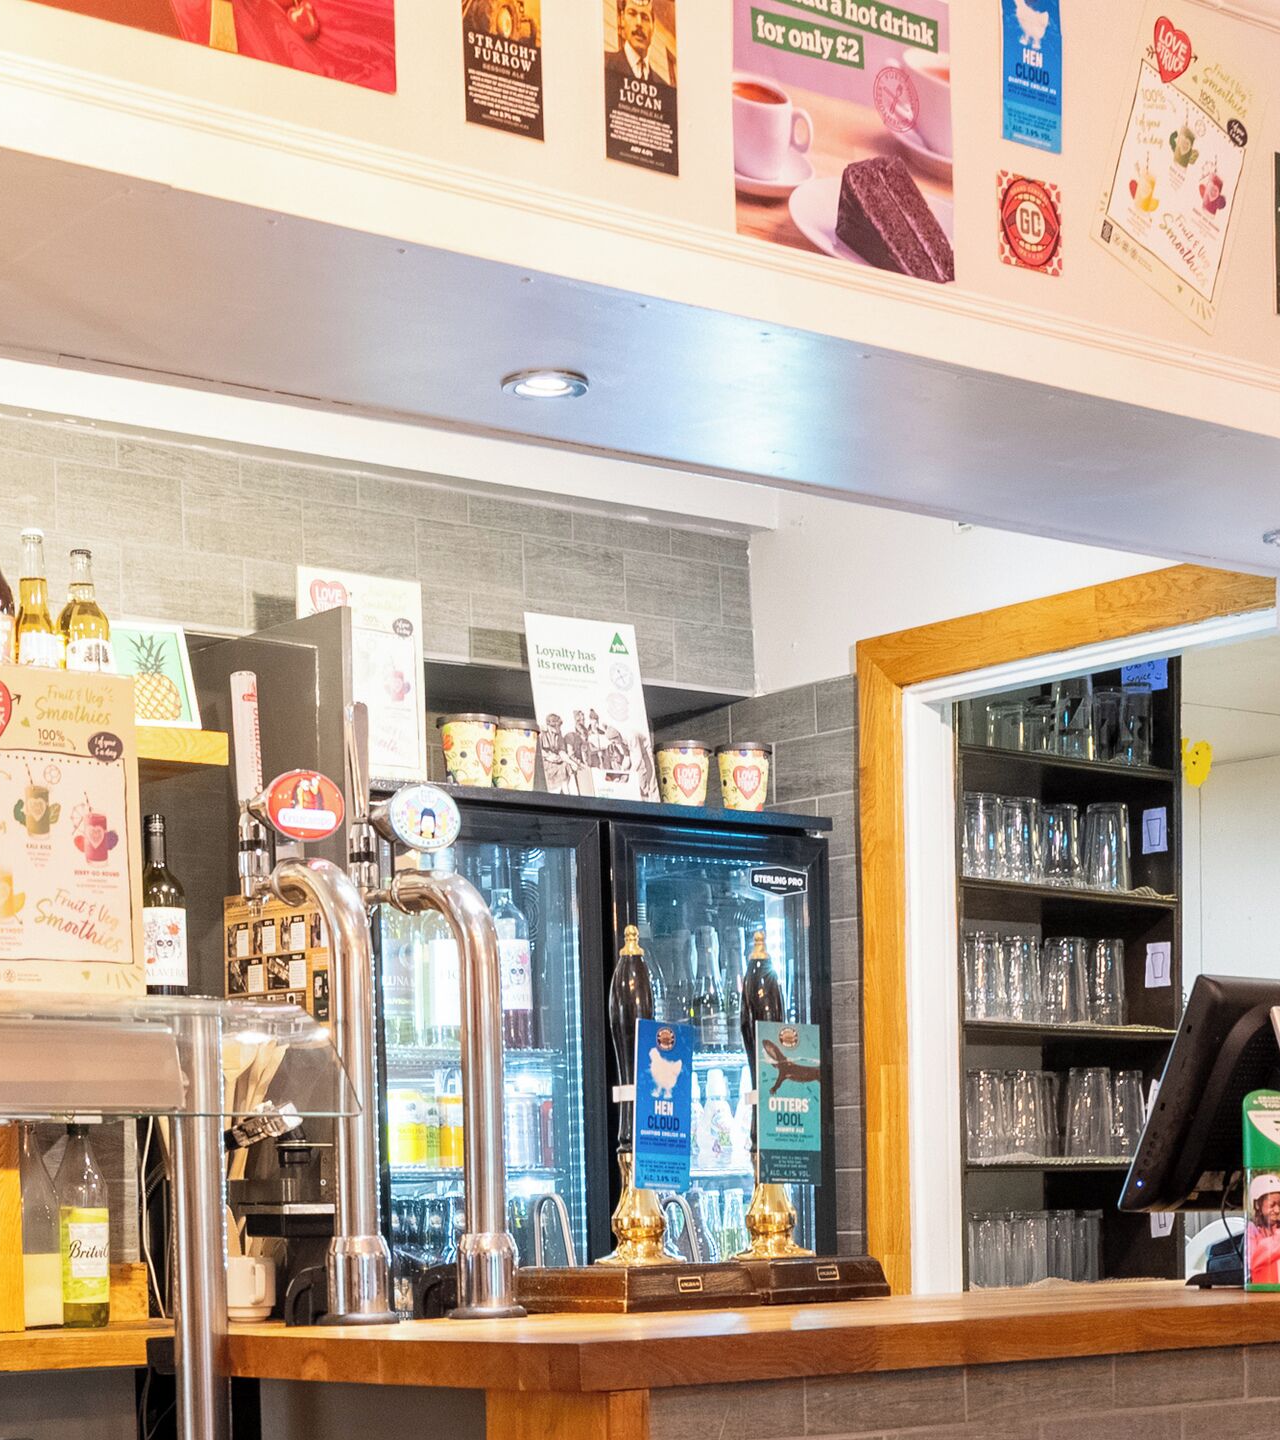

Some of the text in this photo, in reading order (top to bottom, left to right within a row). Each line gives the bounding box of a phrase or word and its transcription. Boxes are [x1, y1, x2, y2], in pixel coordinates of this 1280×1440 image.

[845, 1, 877, 30] hot
[880, 11, 934, 47] drink
[468, 32, 537, 61] STRAIGHT
[756, 15, 860, 63] for only £2
[1159, 25, 1188, 61] LOVE
[474, 47, 532, 72] FURROW
[1023, 48, 1043, 68] HEN
[1157, 42, 1184, 72] STRUCK
[482, 63, 525, 80] SESSION ALE
[1015, 63, 1050, 86] CLOUD
[624, 78, 658, 97] LORD
[620, 89, 662, 111] LUCAN
[1020, 208, 1040, 237] GC
[315, 585, 344, 603] LOVE
[536, 644, 597, 662] Loyalty has
[537, 659, 595, 674] its rewards
[48, 684, 74, 701] Fruit
[85, 688, 105, 708] Veg
[35, 697, 112, 725] Smoothies
[38, 728, 65, 742] 100%
[676, 767, 701, 779] LOVE
[736, 770, 760, 781] LOVE
[754, 874, 803, 887] STERLING PRO
[53, 888, 87, 914] Fruit
[97, 903, 120, 932] Veg
[34, 898, 124, 953] Smoothies
[654, 1101, 673, 1116] HEN
[768, 1098, 811, 1113] OTTERS'
[647, 1115, 680, 1130] CLOUD
[776, 1112, 804, 1127] POOL
